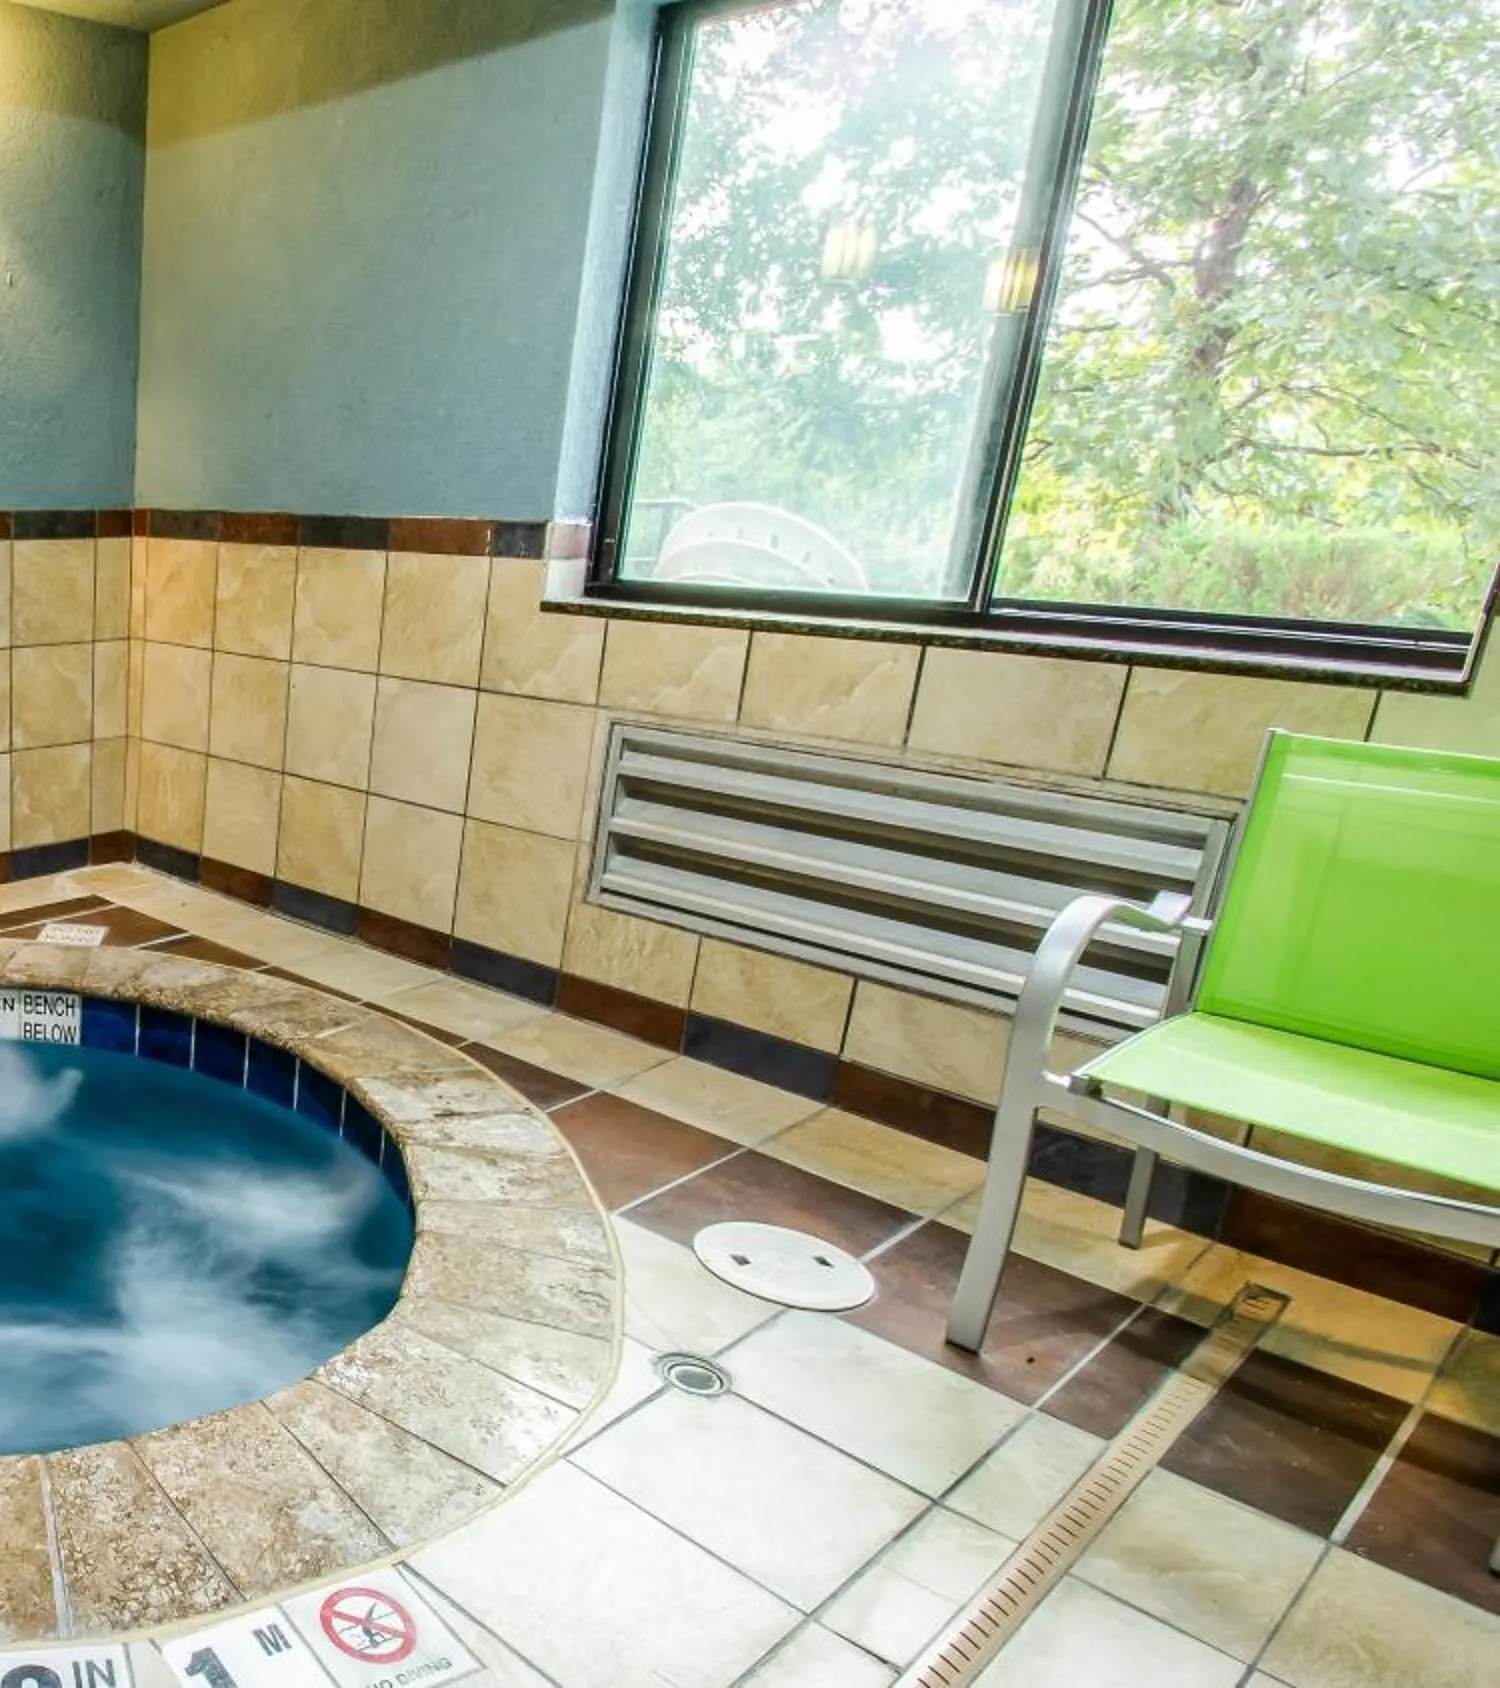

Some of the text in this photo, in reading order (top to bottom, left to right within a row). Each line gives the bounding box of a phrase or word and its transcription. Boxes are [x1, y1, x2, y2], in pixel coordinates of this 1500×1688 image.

[23, 995, 75, 1016] BENCH
[23, 1022, 77, 1043] BELOW
[252, 1622, 292, 1656] M
[72, 1659, 116, 1688] IN
